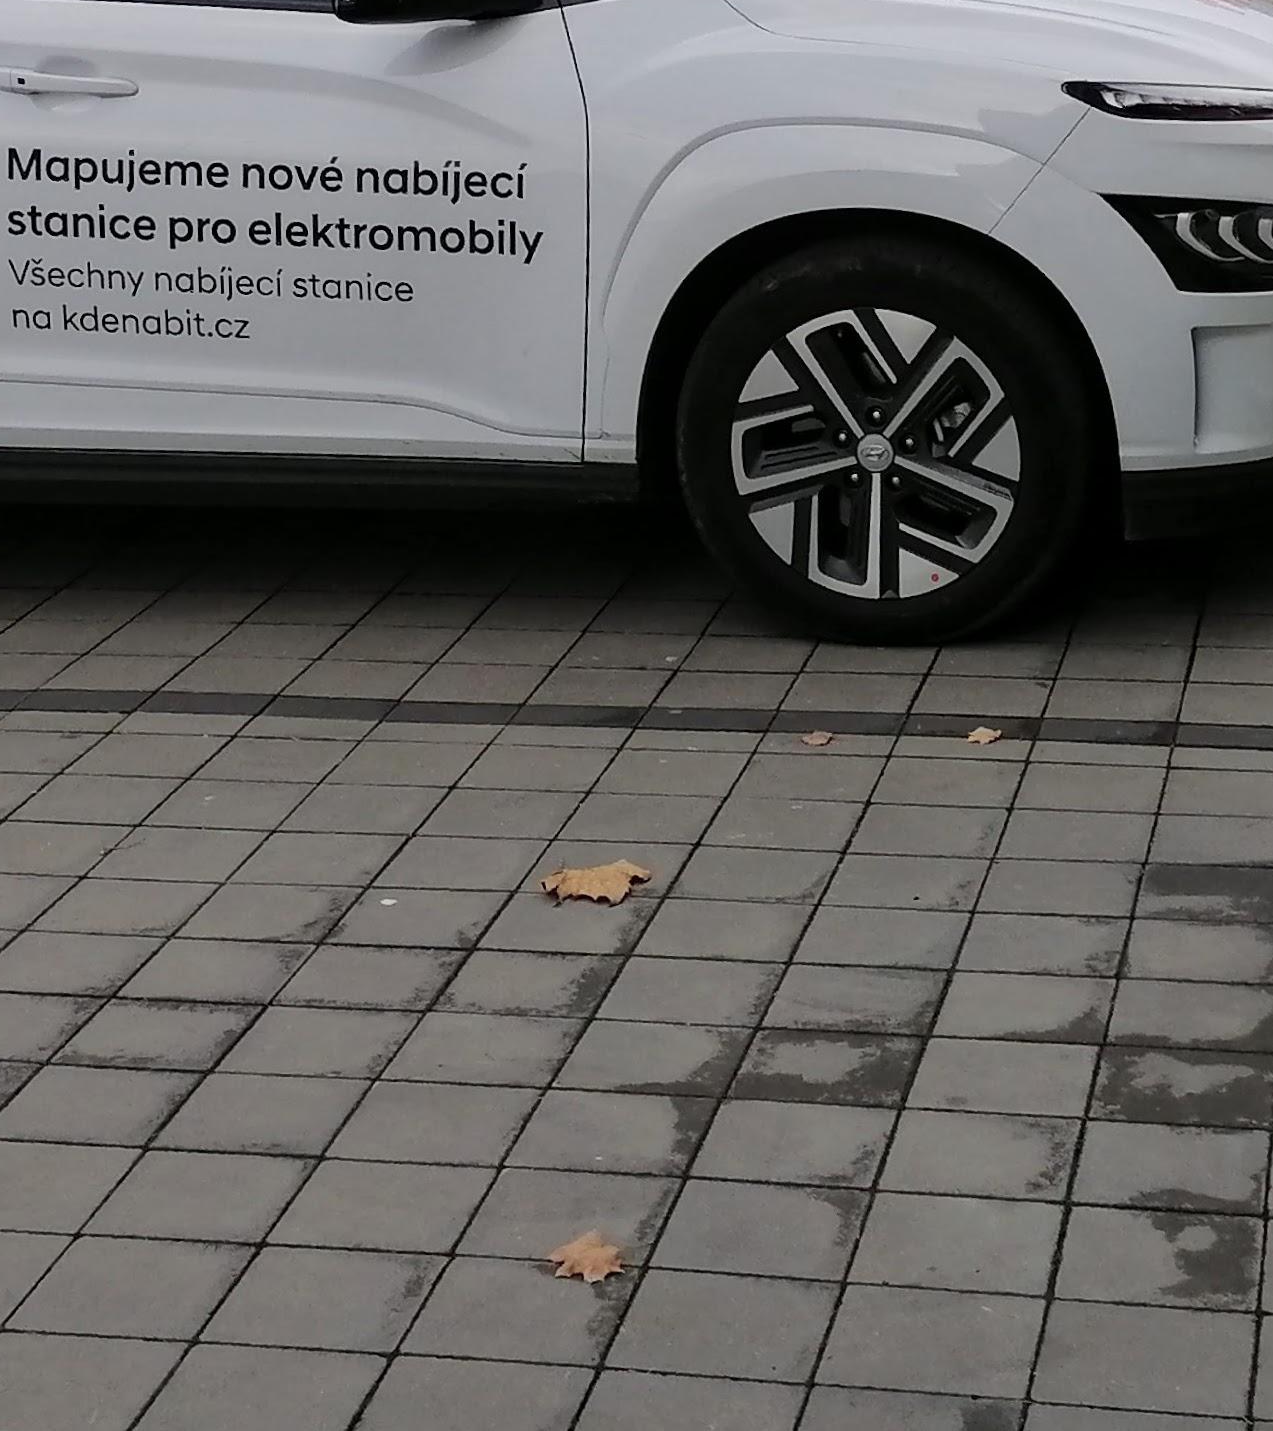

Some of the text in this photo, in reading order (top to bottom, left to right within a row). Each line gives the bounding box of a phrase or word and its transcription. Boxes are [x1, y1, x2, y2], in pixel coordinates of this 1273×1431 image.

[7, 147, 528, 205] Mapujeme nové nabíjecí
[7, 203, 544, 265] stanice pro elektromobily
[7, 258, 415, 303] Všechny nabíjecí stanice
[11, 303, 251, 340] na kdenabit.cz
